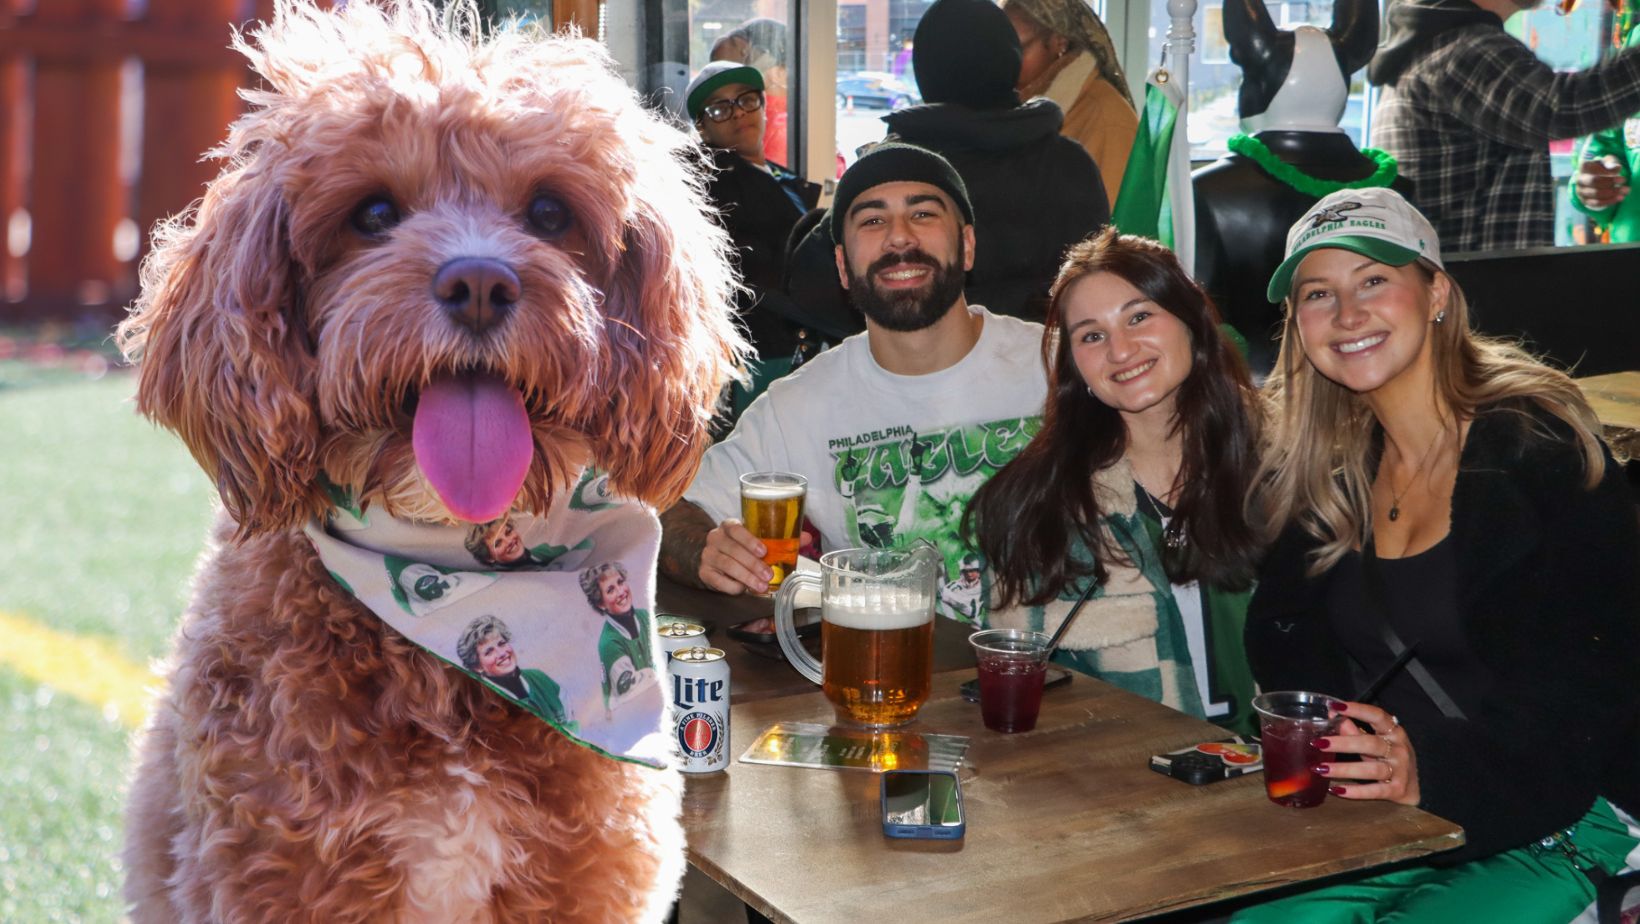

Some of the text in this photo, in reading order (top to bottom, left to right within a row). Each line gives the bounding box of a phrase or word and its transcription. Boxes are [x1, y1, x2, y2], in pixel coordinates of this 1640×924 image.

[1350, 220, 1386, 230] EAGLES
[828, 424, 914, 449] PHILADELPHIA
[673, 674, 723, 710] Lite
[682, 713, 695, 725] FINE
